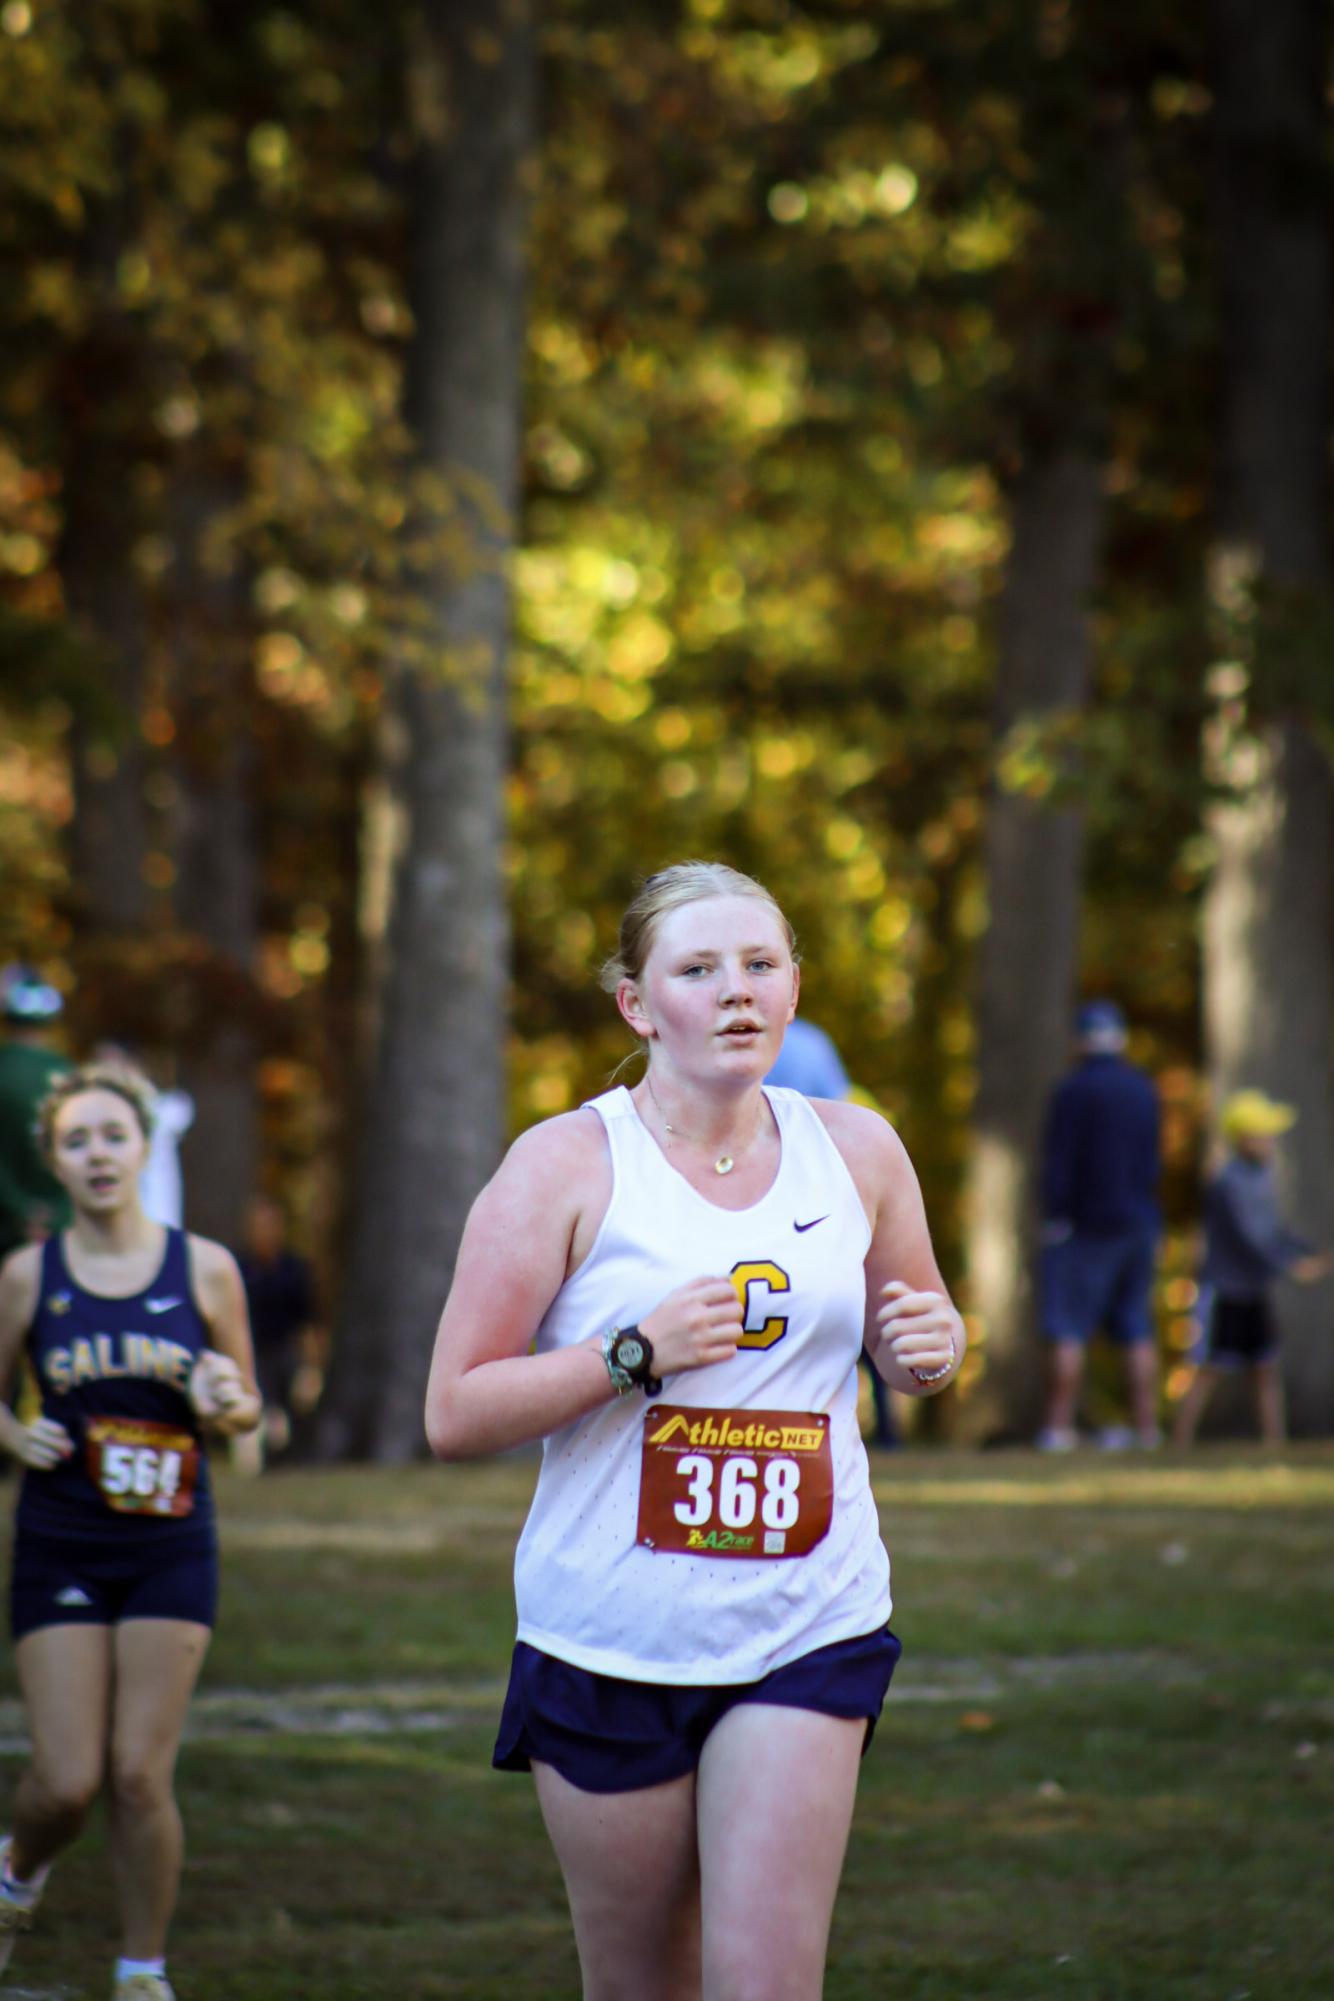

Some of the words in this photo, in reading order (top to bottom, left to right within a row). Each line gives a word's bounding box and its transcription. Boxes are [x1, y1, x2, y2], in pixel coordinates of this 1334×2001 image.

[730, 1260, 791, 1351] C
[785, 1432, 819, 1447] NET
[674, 1454, 801, 1530] 368
